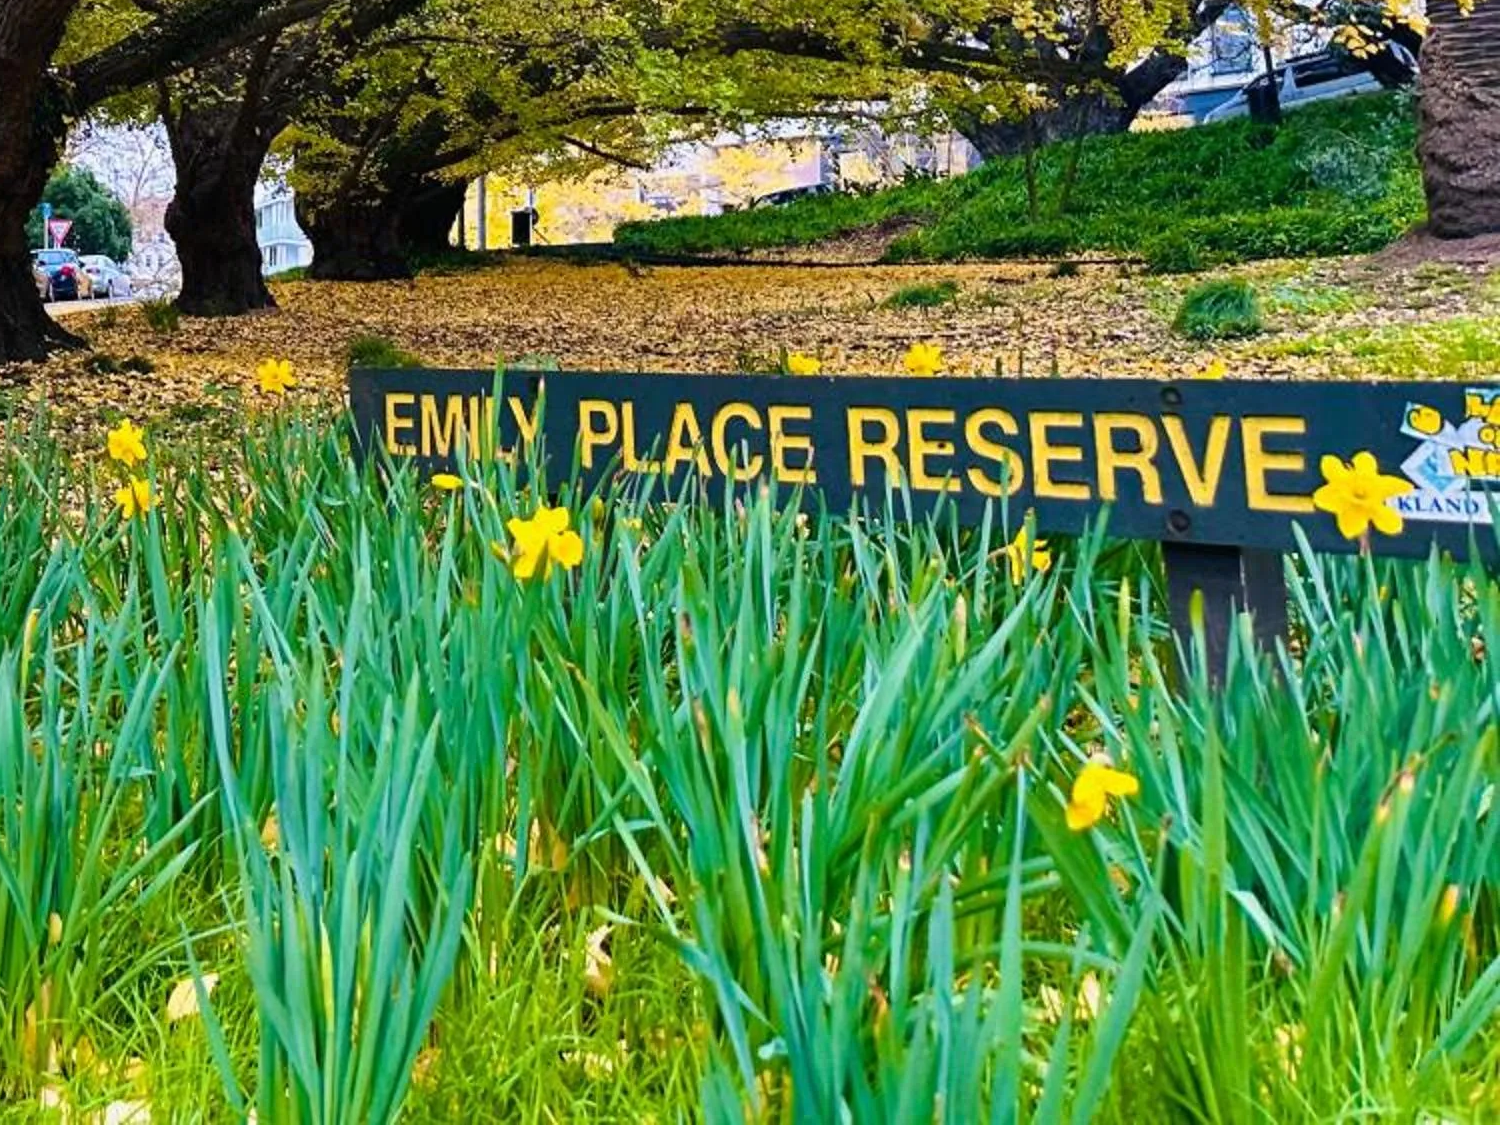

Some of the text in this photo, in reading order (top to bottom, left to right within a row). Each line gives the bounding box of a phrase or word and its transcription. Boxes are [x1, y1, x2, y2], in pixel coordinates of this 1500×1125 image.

[385, 393, 1317, 514] EMILY PLACE RESERVE
[1397, 496, 1480, 514] KLAND
